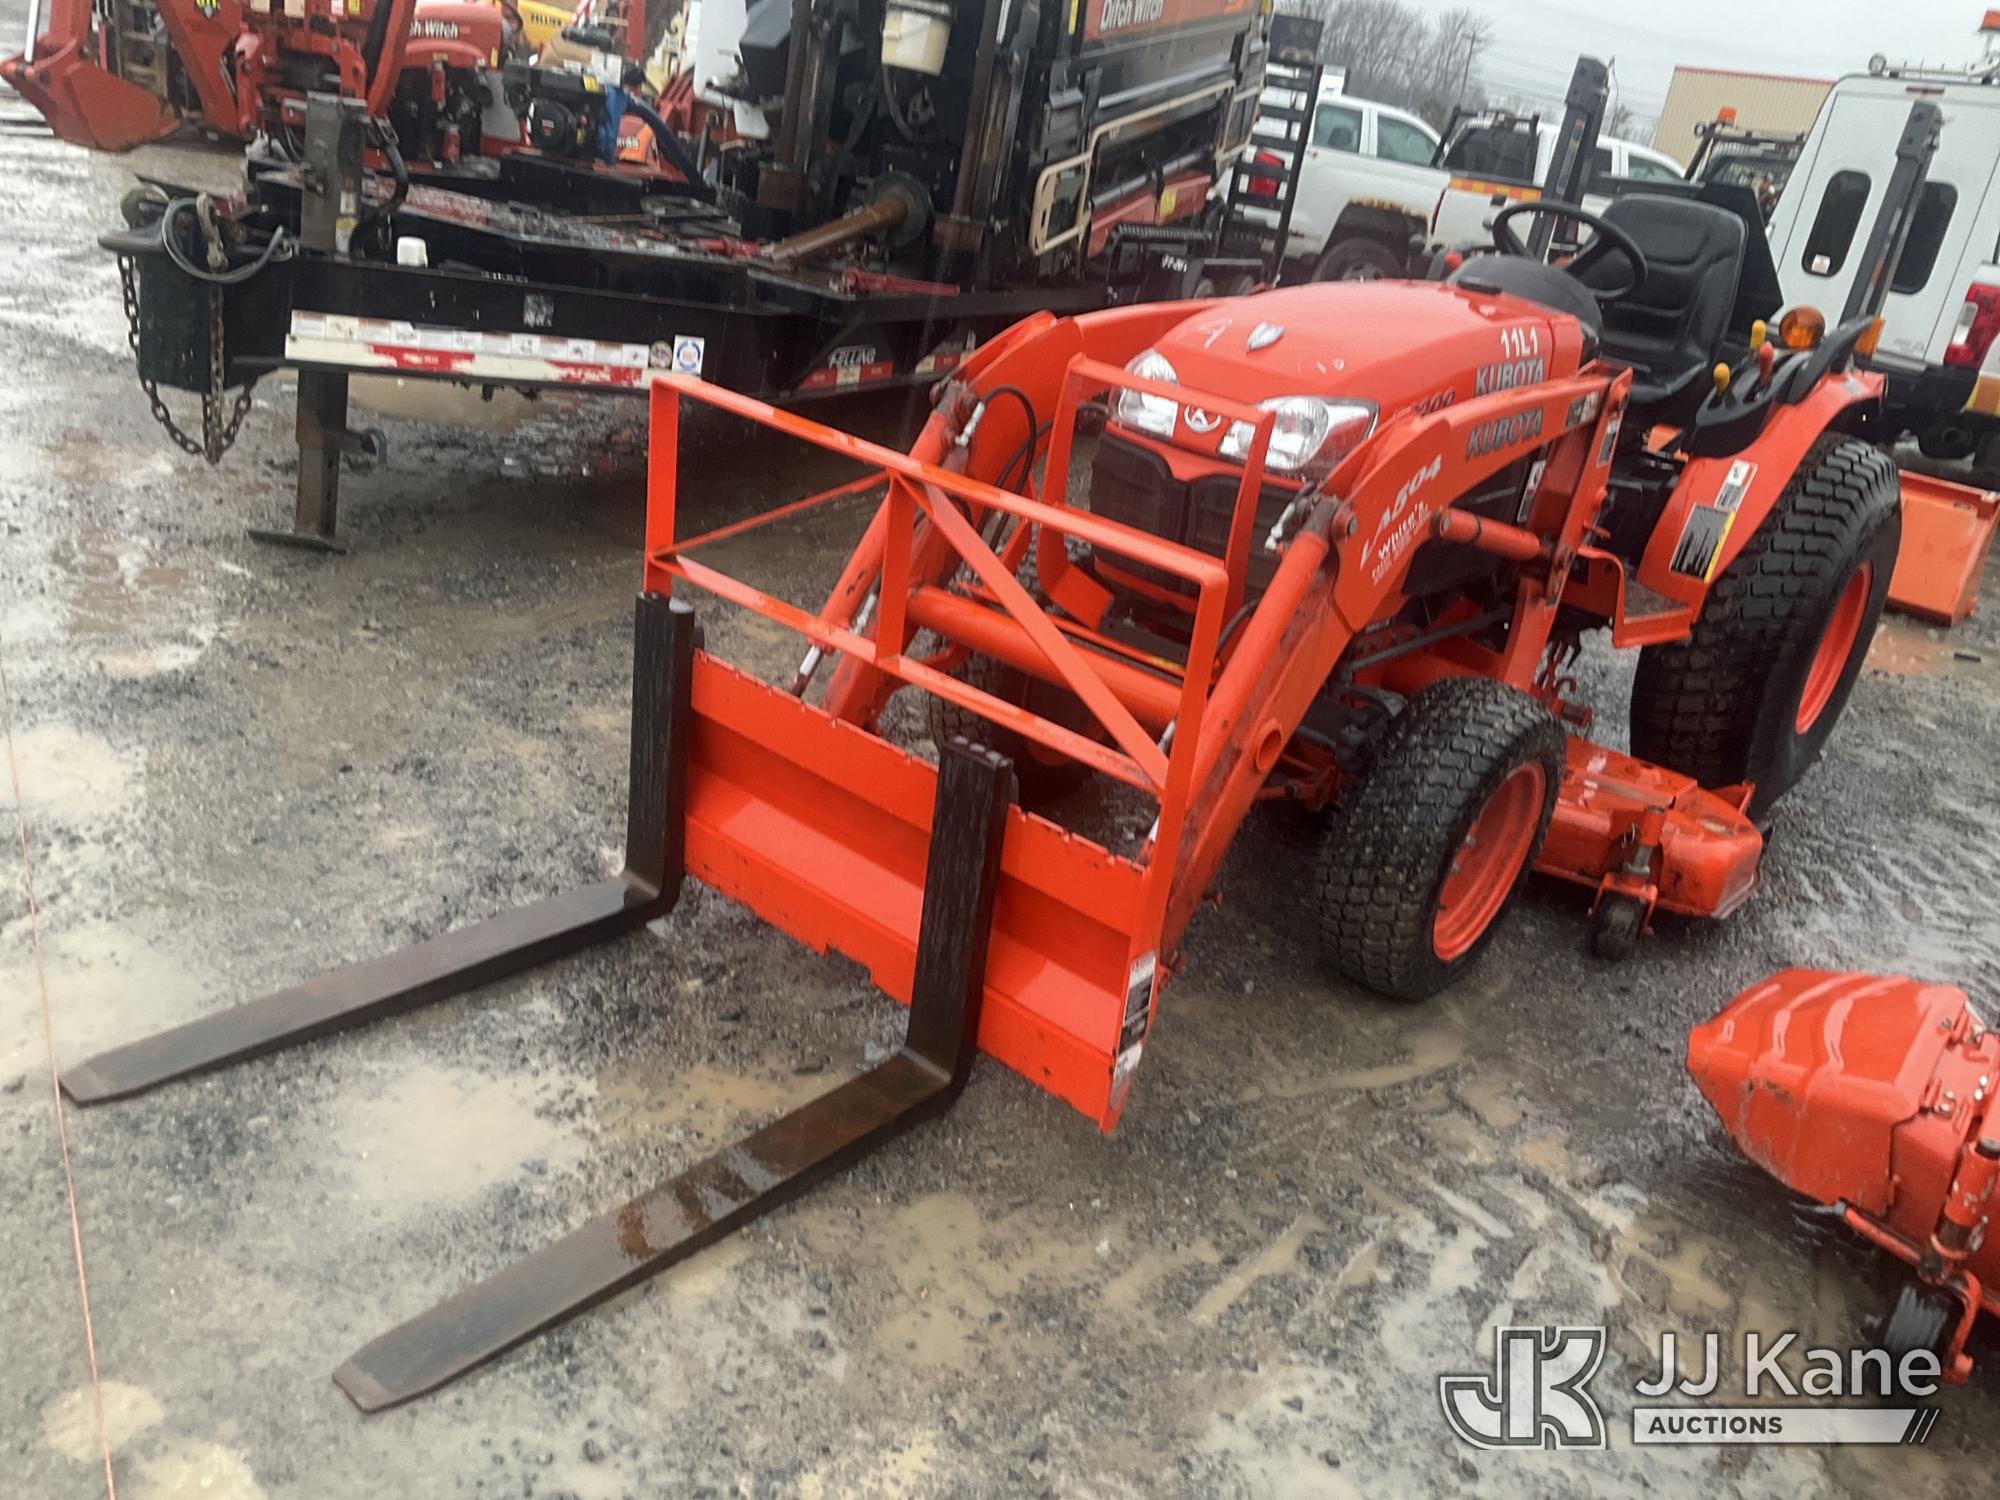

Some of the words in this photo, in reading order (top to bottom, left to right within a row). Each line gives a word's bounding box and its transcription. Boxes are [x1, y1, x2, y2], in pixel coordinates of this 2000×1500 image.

[425, 19, 459, 39] Witch
[1500, 326, 1538, 359] 11L1
[1474, 357, 1544, 399] KUBOTA
[1465, 407, 1544, 461] KUBOTA
